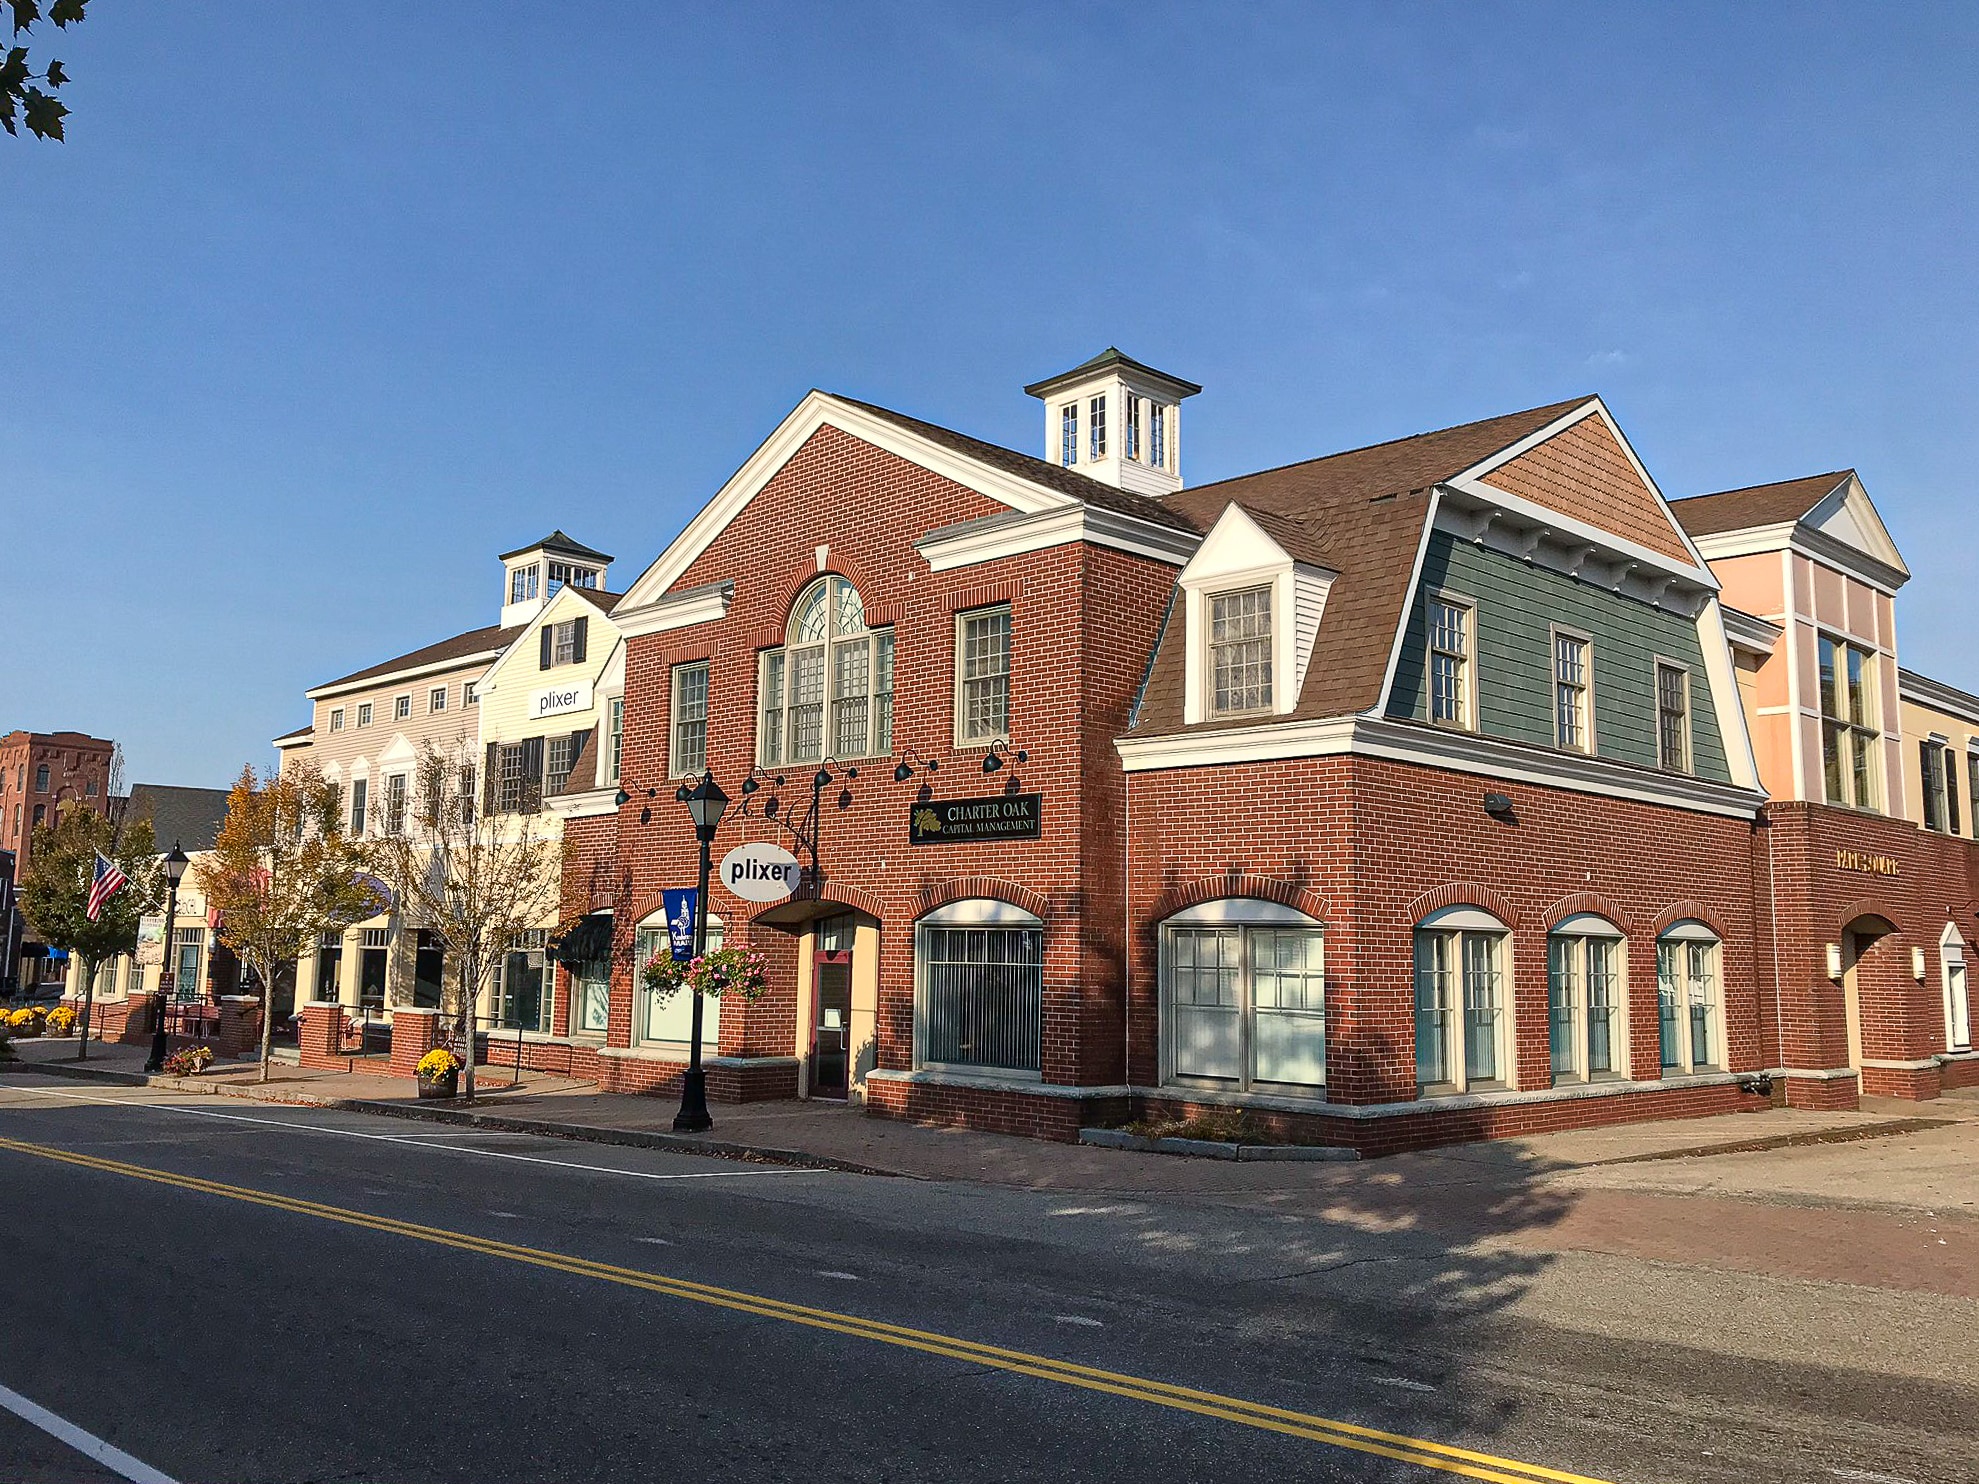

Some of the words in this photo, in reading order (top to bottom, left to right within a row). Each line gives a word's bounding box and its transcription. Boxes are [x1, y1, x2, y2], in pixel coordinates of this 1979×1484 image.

[540, 690, 579, 715] plixer
[947, 803, 1000, 821] CHARTER
[1003, 801, 1030, 817] OAK
[942, 822, 975, 835] CAPITAL
[976, 819, 1036, 833] MANAGEMENT
[731, 858, 792, 884] plixer
